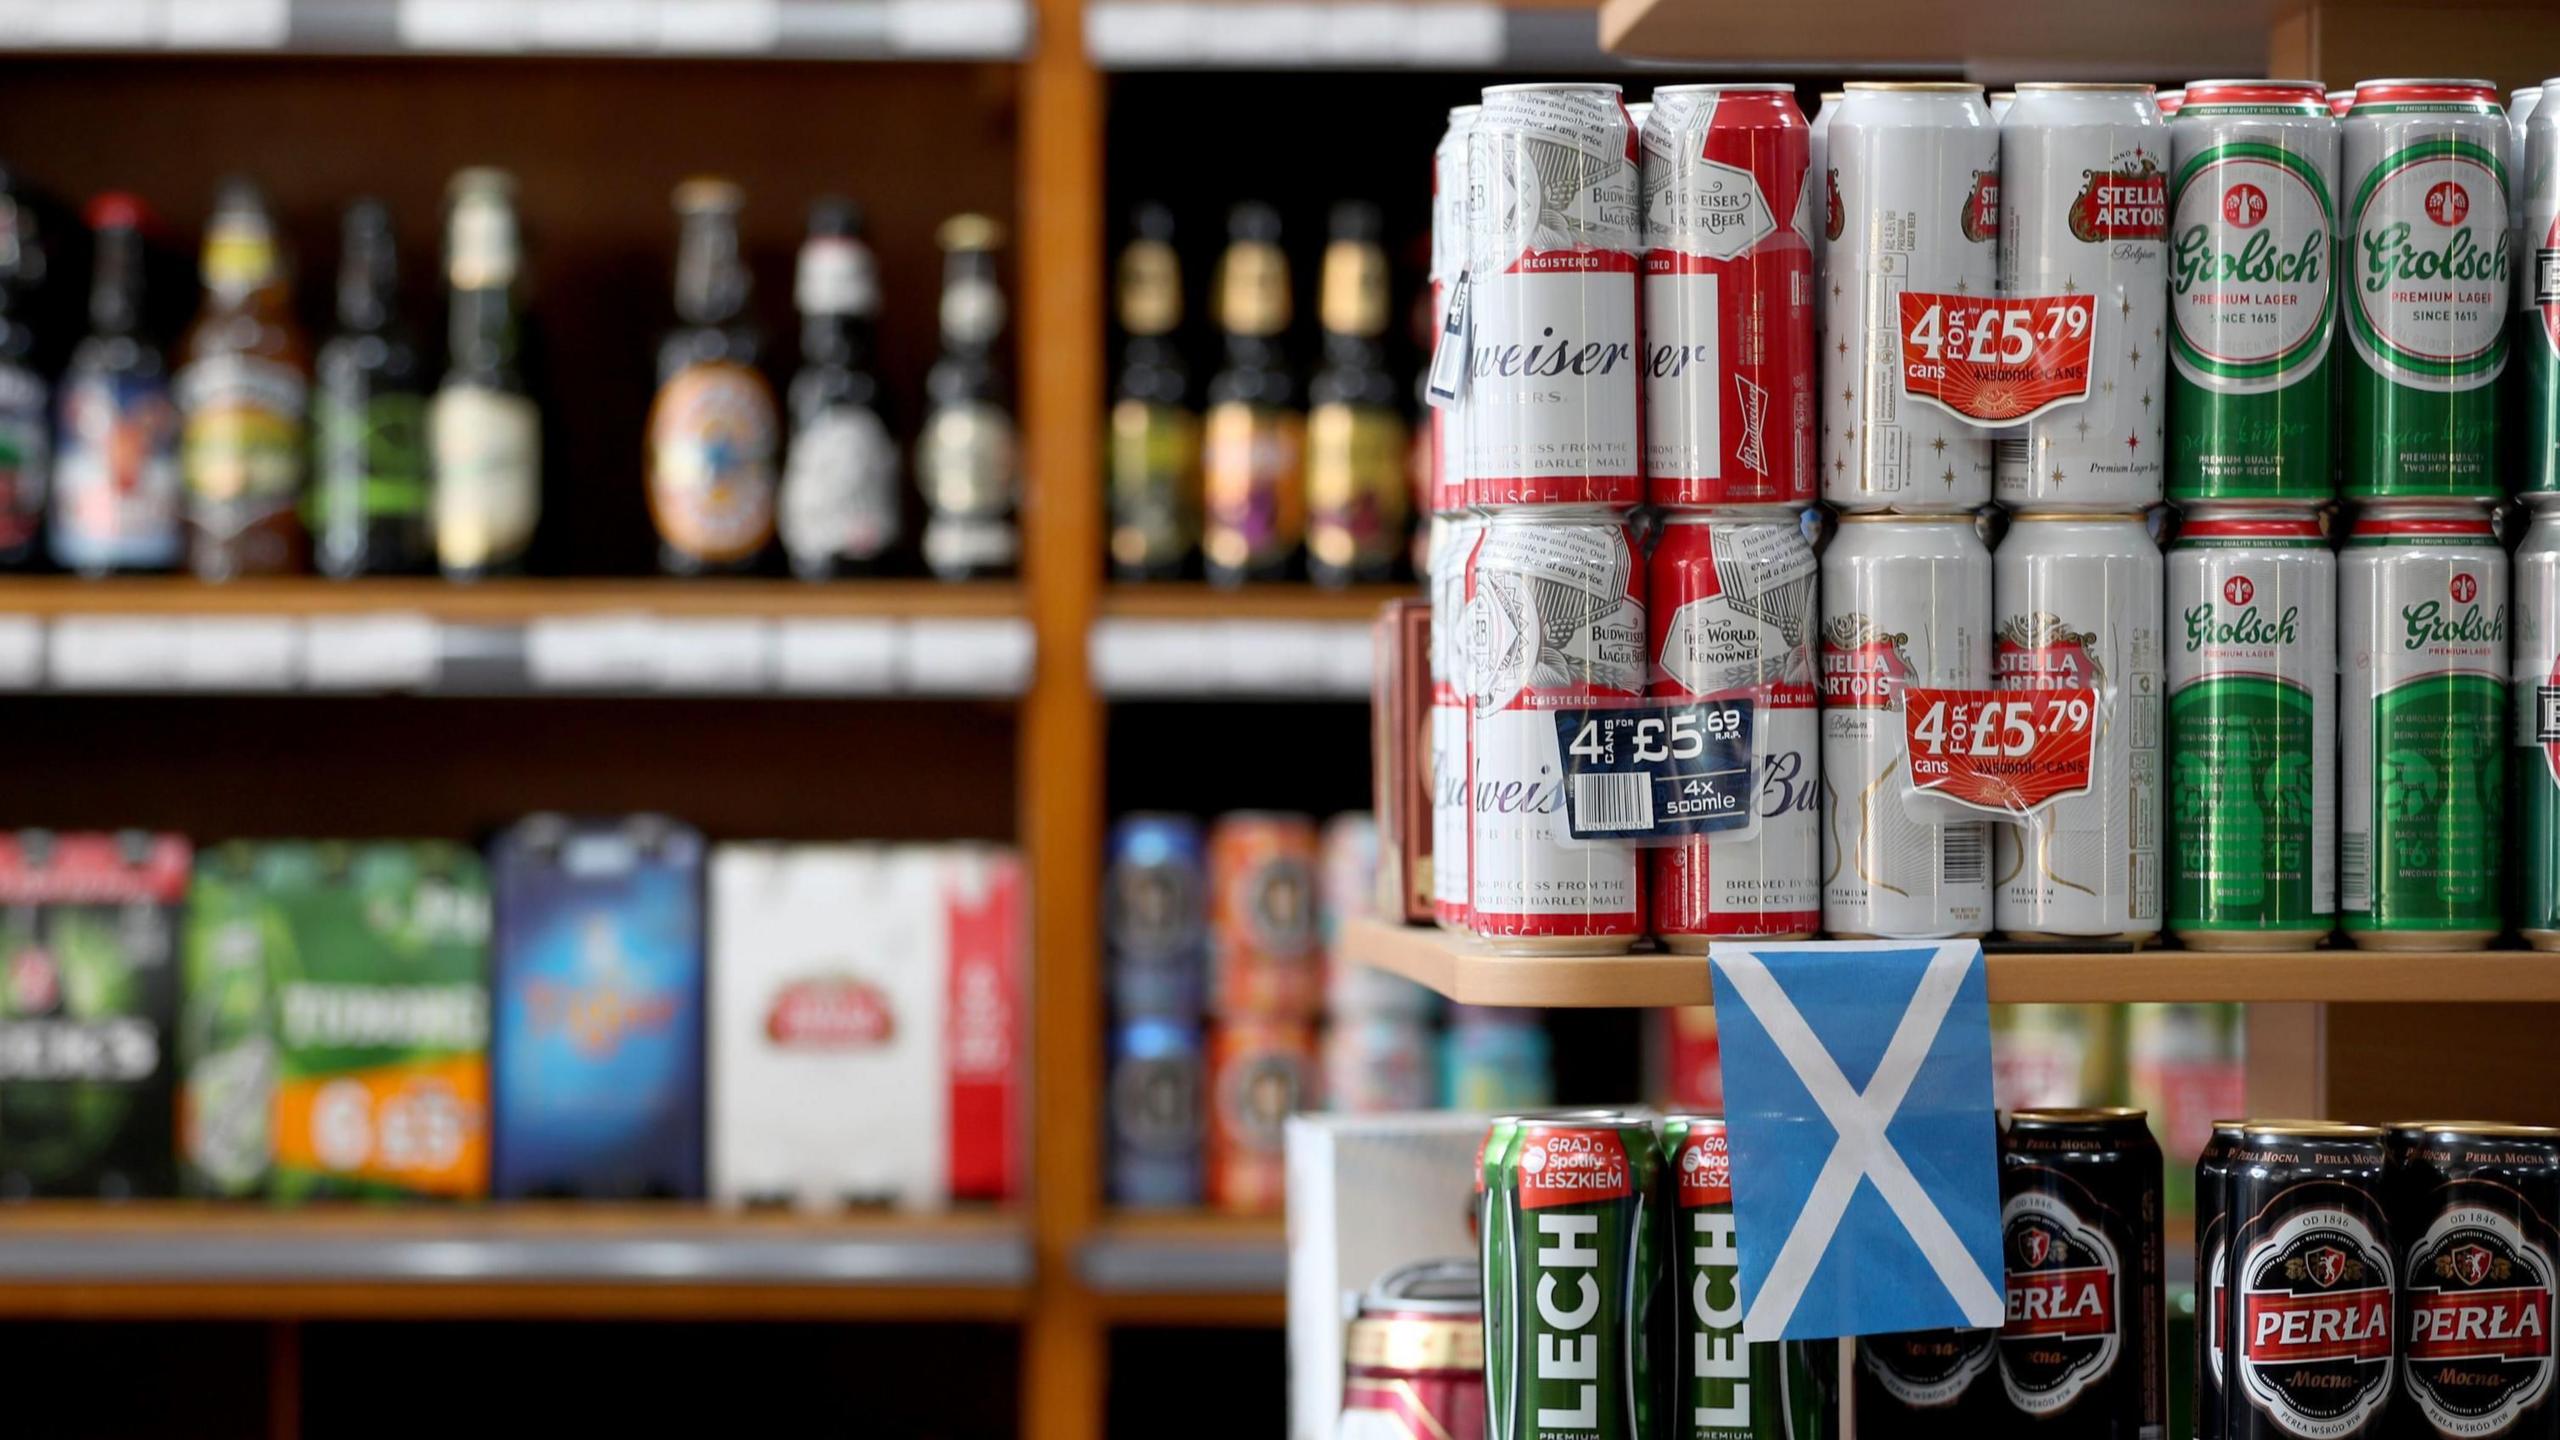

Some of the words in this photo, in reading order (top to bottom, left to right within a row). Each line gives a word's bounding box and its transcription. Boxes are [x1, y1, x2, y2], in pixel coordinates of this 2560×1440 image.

[1549, 99, 1566, 111] and
[2229, 107, 2258, 115] QUALITY
[2396, 105, 2428, 113] PREMIUM
[2429, 105, 2458, 113] QUALITY
[1558, 126, 1579, 140] any
[2097, 186, 2165, 205] STELLA
[2095, 207, 2165, 226] ARTOIS
[1523, 256, 1599, 269] REGISTERED
[2174, 224, 2321, 295] Grolsch
[2363, 222, 2509, 293] Grolsch
[2192, 294, 2250, 305] PREMIUM
[2255, 294, 2298, 305] LAGER
[2392, 292, 2453, 304] PREMIUM
[2210, 313, 2246, 324] SNCE
[2251, 313, 2277, 323] 1615
[2412, 310, 2450, 322] SINCE
[2455, 311, 2478, 321] 1615
[1910, 305, 1945, 360] 4
[1947, 308, 1966, 360] FOR
[1966, 305, 2088, 364] £5.79
[1474, 324, 1629, 377] weiser
[1908, 363, 1946, 380] cans
[1561, 443, 1601, 453] FROM
[1607, 442, 1628, 452] THE
[2198, 455, 2241, 465] PREMIUM
[2244, 455, 2285, 465] QUALITY
[2400, 453, 2446, 462] PREMIUM
[2404, 463, 2425, 473] TWO
[1528, 531, 1548, 543] brew
[1549, 537, 1568, 548] and
[1569, 541, 1588, 554] age.
[1590, 549, 1607, 561] Our
[1567, 529, 1607, 549] produced
[1742, 535, 1758, 549] This
[1549, 549, 1605, 573] smoothness
[1545, 561, 1556, 570] at
[1558, 564, 1578, 577] any
[1579, 570, 1604, 586] price.
[2184, 603, 2299, 652] Grolsch
[2402, 600, 2505, 650] Grolsch
[2245, 650, 2275, 658] LAGER
[2428, 648, 2468, 656] PREMIUM
[2000, 653, 2078, 673] STELLA
[1523, 694, 1599, 706] REGISTERED
[1759, 694, 1793, 704] TRADE
[1615, 719, 1634, 728] FOR
[1914, 701, 1948, 755] 4
[1950, 703, 1968, 755] FOR
[1968, 700, 2088, 757] £5.79
[1569, 719, 1605, 765] 4
[1604, 719, 1615, 764] CANS
[1632, 709, 1741, 764] £5.69
[1914, 759, 1949, 774] cans
[1684, 779, 1714, 796] 4x
[1557, 880, 1598, 891] FROM
[1604, 879, 1625, 890] THE
[1726, 879, 1785, 890] BREWED
[1789, 879, 1802, 889] BY
[1726, 895, 1794, 905] CHOCEST
[1547, 1137, 1591, 1153] GRAJ
[2261, 1151, 2299, 1163] MOCNA
[2504, 1152, 2545, 1164] MOCNA
[1536, 1172, 1622, 1189] LESZKIEM
[2302, 1215, 2320, 1227] OD
[2323, 1214, 2350, 1227] 1846
[2450, 1214, 2466, 1225] OD
[2469, 1212, 2496, 1225] 1846
[1535, 1214, 1601, 1429] LECH
[1692, 1213, 1751, 1428] LECH
[2253, 1303, 2387, 1347] PERŁA
[2410, 1303, 2543, 1343] PERŁA
[2346, 1413, 2362, 1427] PIW
[2492, 1411, 2509, 1427] PIW
[1696, 1430, 1754, 1440] PREMIUM
